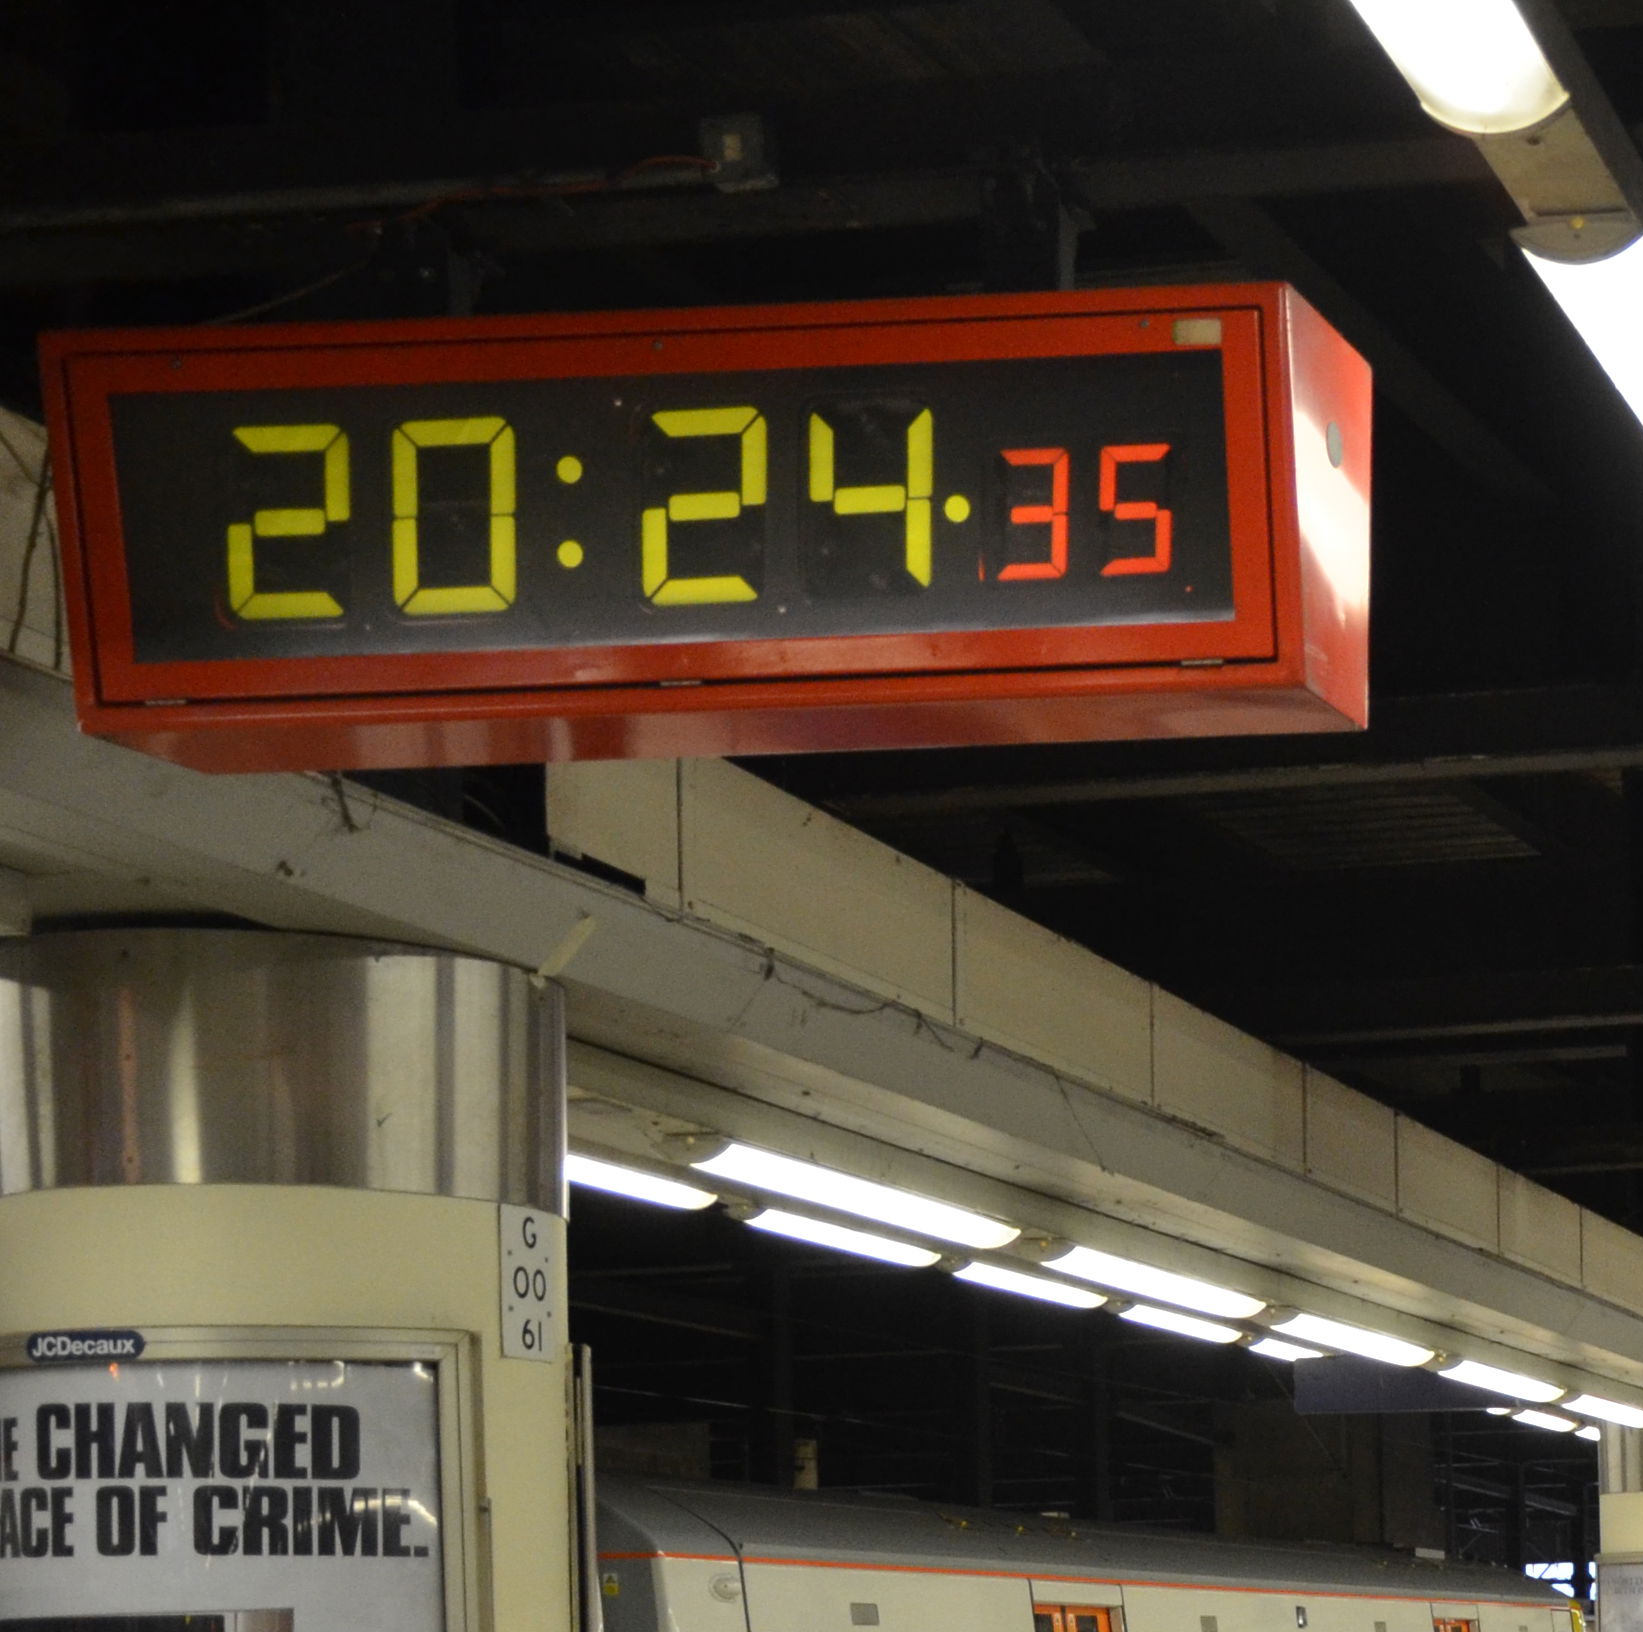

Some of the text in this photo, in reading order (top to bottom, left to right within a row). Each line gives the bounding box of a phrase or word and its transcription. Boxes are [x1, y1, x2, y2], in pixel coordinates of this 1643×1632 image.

[523, 1216, 537, 1248] G
[32, 1337, 136, 1358] JCDecaux
[522, 1318, 542, 1351] 61
[0, 1402, 361, 1481] E CHANGED
[0, 1486, 430, 1558] ACE OF CRIME.
